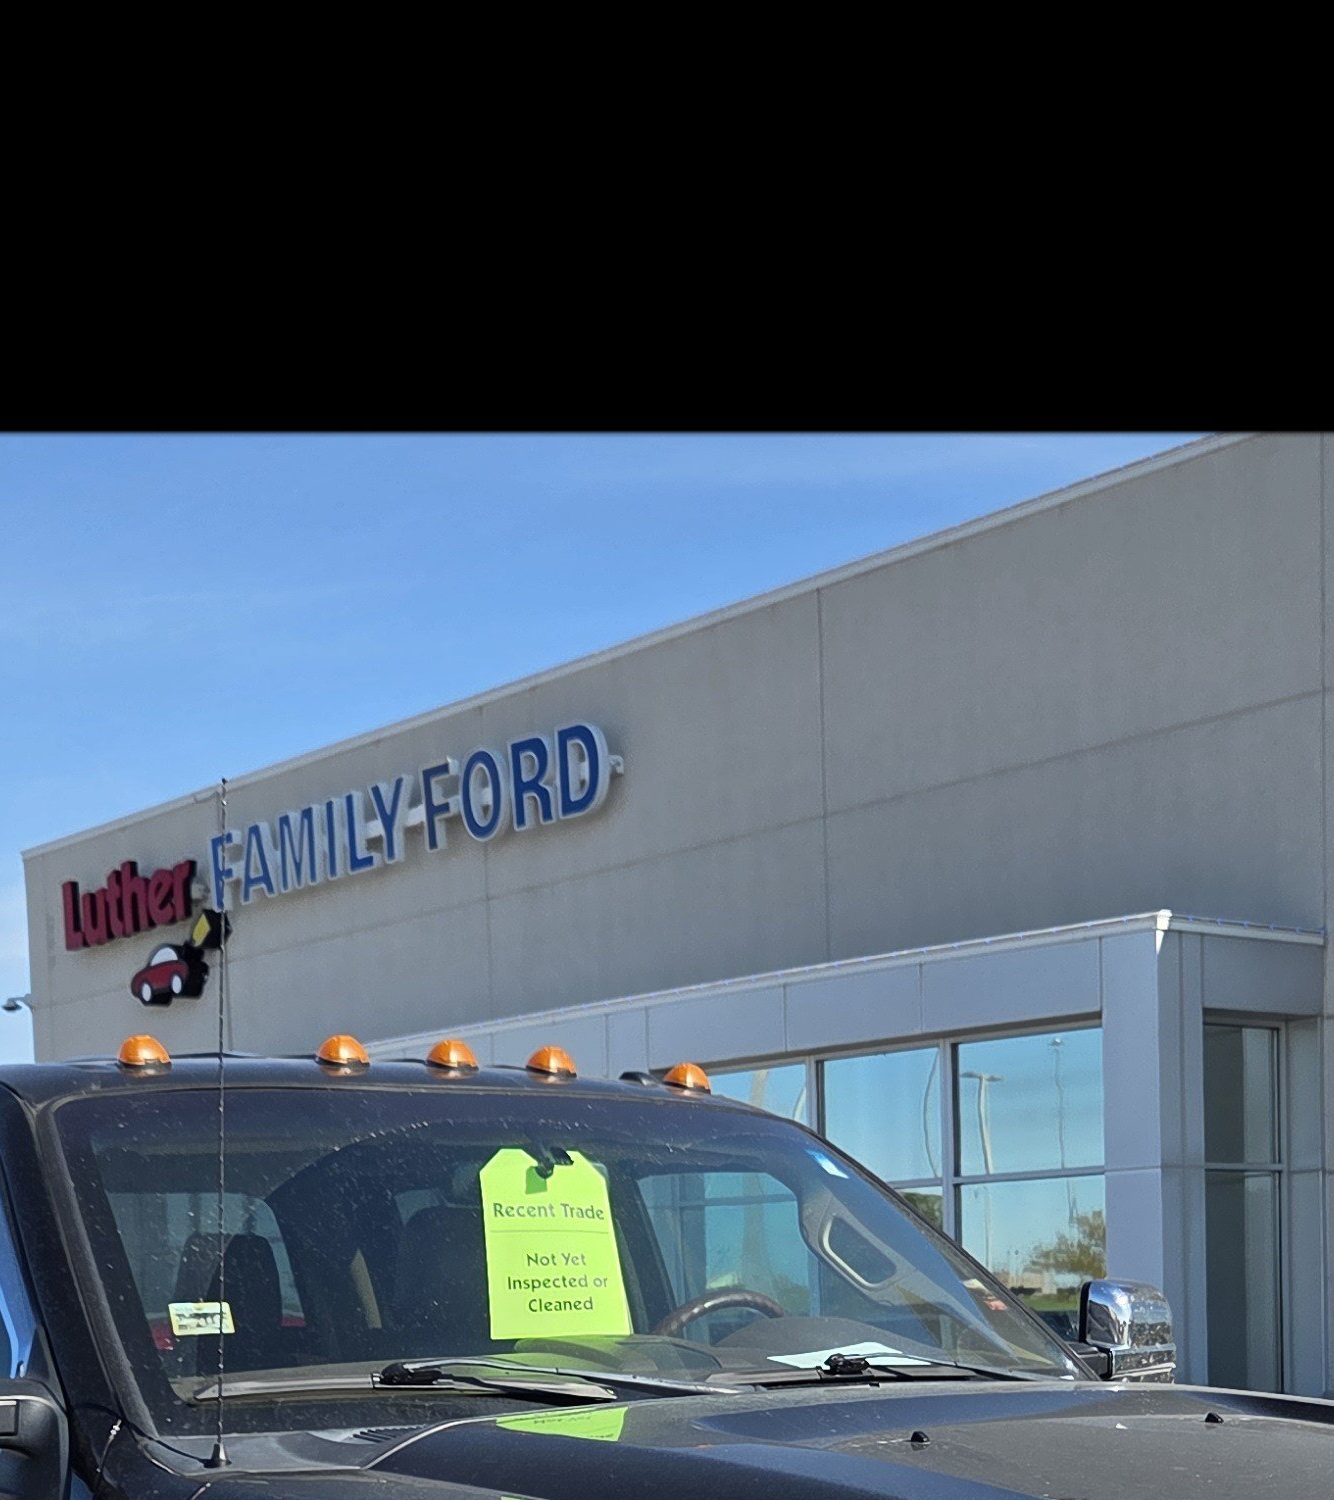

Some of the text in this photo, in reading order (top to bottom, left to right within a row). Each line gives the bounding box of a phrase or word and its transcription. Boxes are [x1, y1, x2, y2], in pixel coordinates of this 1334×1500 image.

[209, 722, 609, 912] FAMILY FORD
[61, 858, 197, 951] Luther
[492, 1202, 605, 1220] Recent Trade
[526, 1252, 587, 1267] Not Yet
[507, 1274, 609, 1292] Inspected or
[528, 1296, 594, 1312] Cleaned
